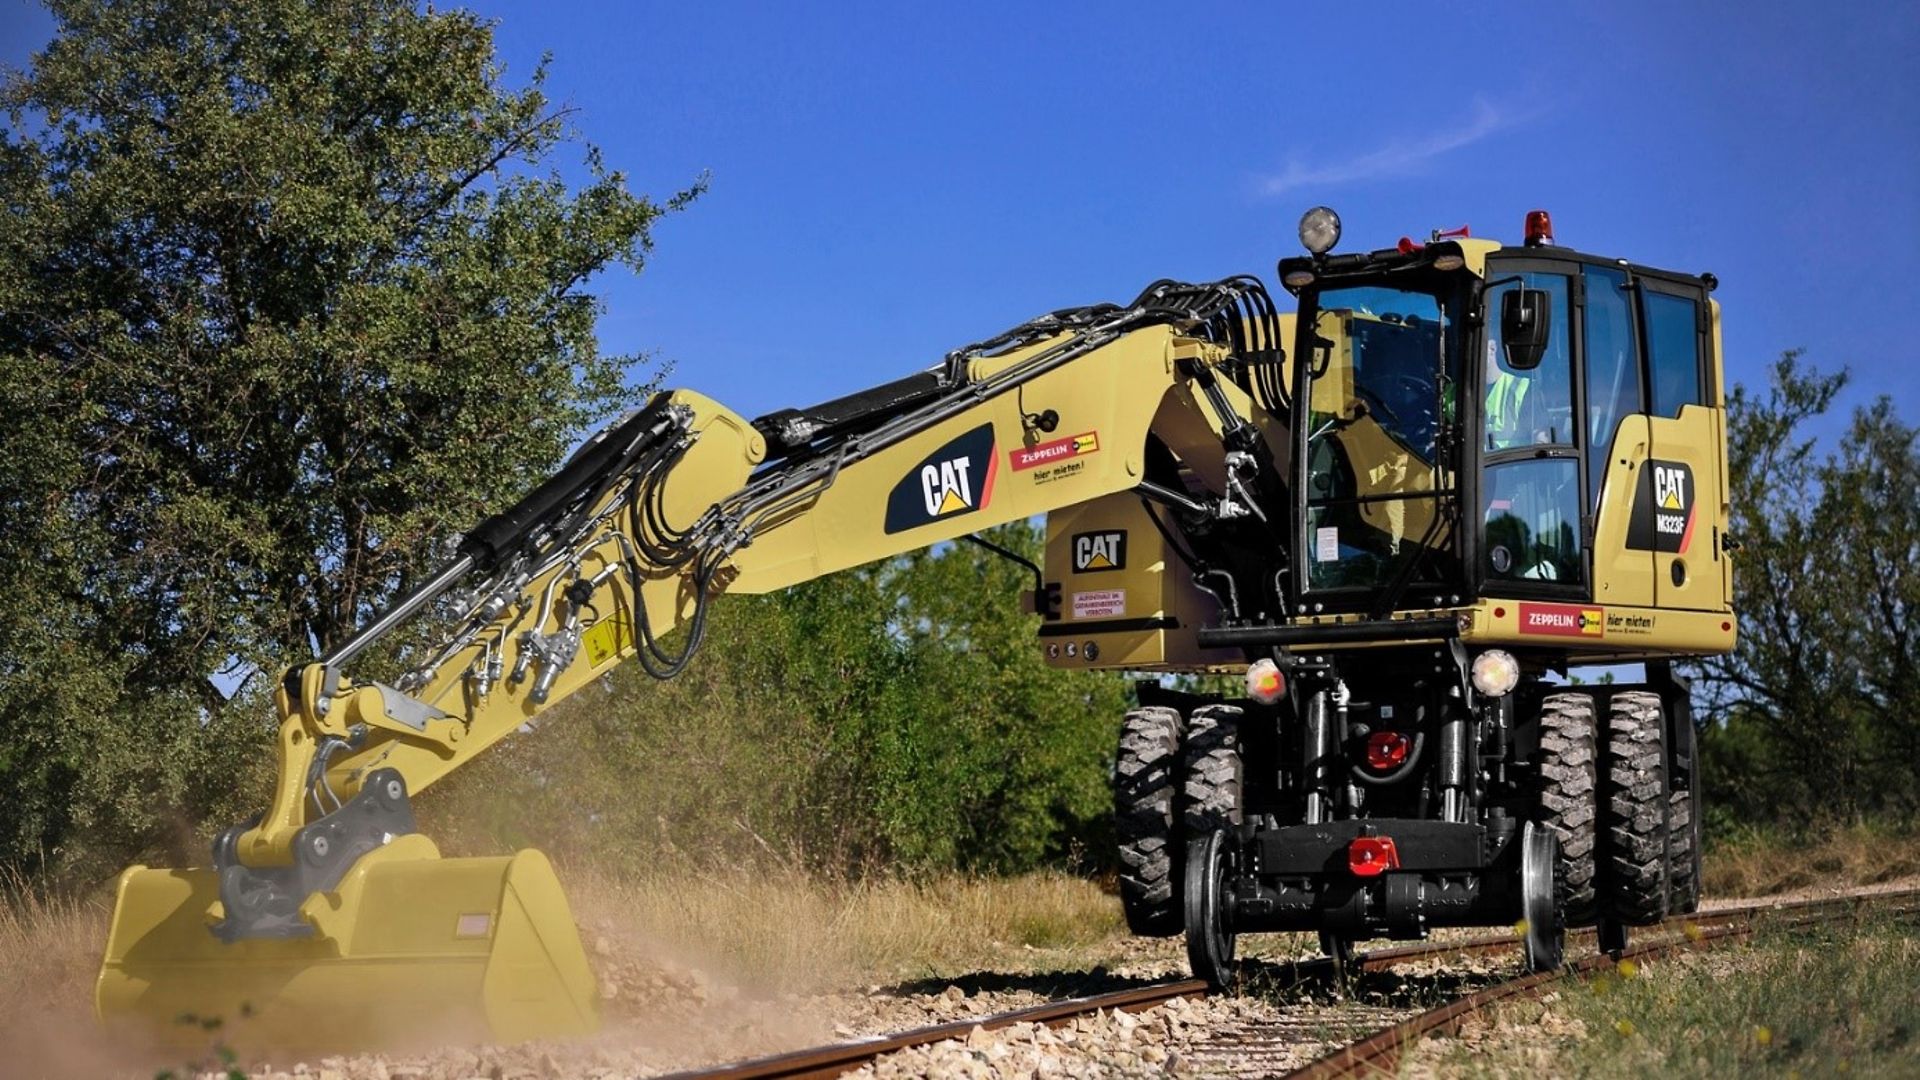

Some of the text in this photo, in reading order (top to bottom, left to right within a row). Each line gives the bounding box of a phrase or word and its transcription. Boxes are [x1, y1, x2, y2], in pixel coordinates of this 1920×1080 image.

[1021, 444, 1068, 464] ZEPPELIN
[921, 455, 972, 516] CAT
[1033, 470, 1051, 481] hier
[1655, 466, 1685, 509] CAT
[1656, 513, 1684, 535] M323F
[1077, 534, 1121, 569] CAT
[1528, 613, 1574, 627] ZEPPELIN
[1607, 613, 1623, 626] hier
